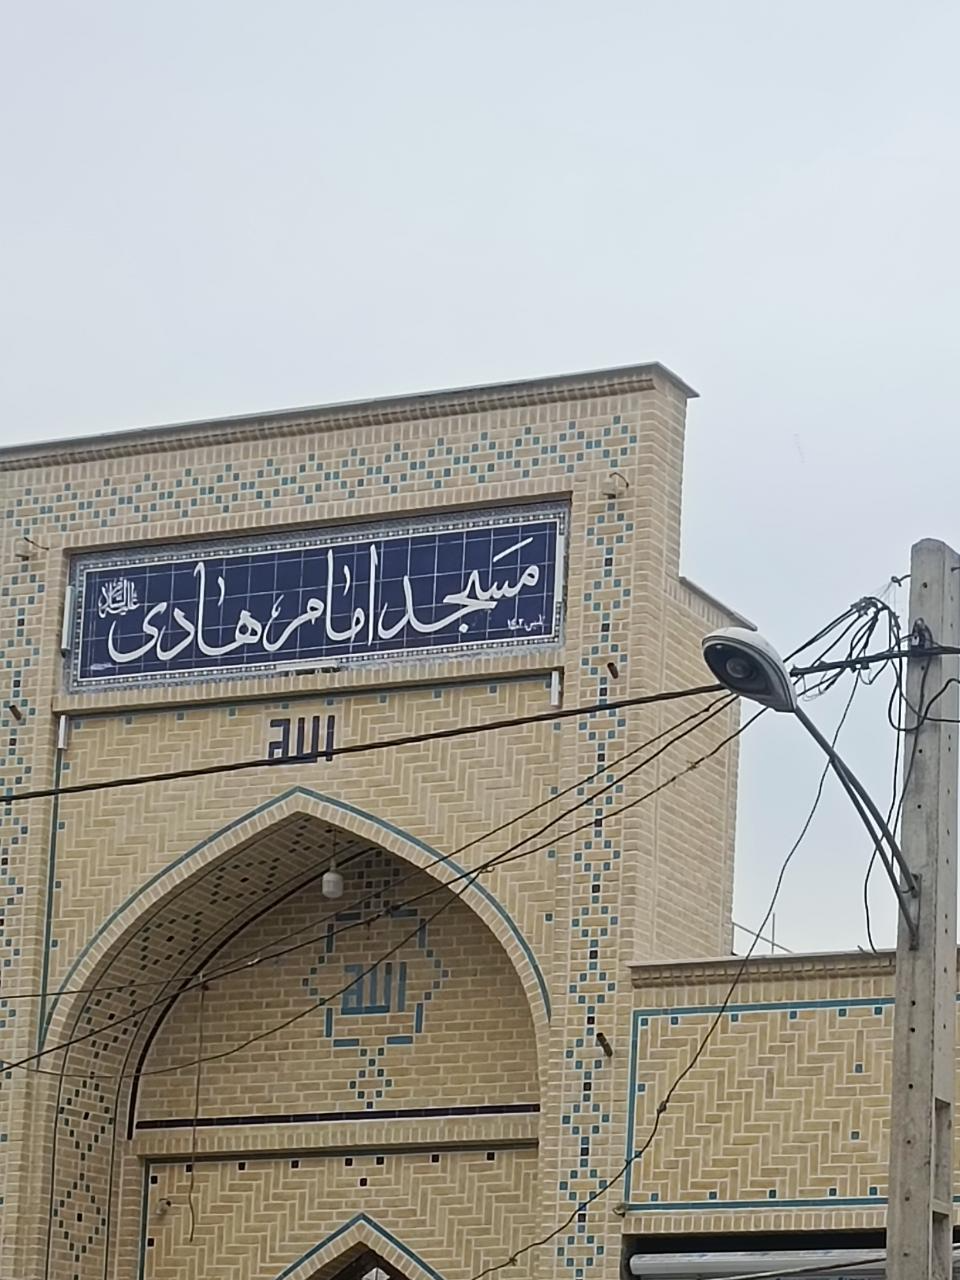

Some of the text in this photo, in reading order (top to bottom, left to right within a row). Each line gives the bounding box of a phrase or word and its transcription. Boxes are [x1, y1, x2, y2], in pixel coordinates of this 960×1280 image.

[107, 537, 540, 663] مسجد امام هادی
[268, 714, 335, 764] الله
